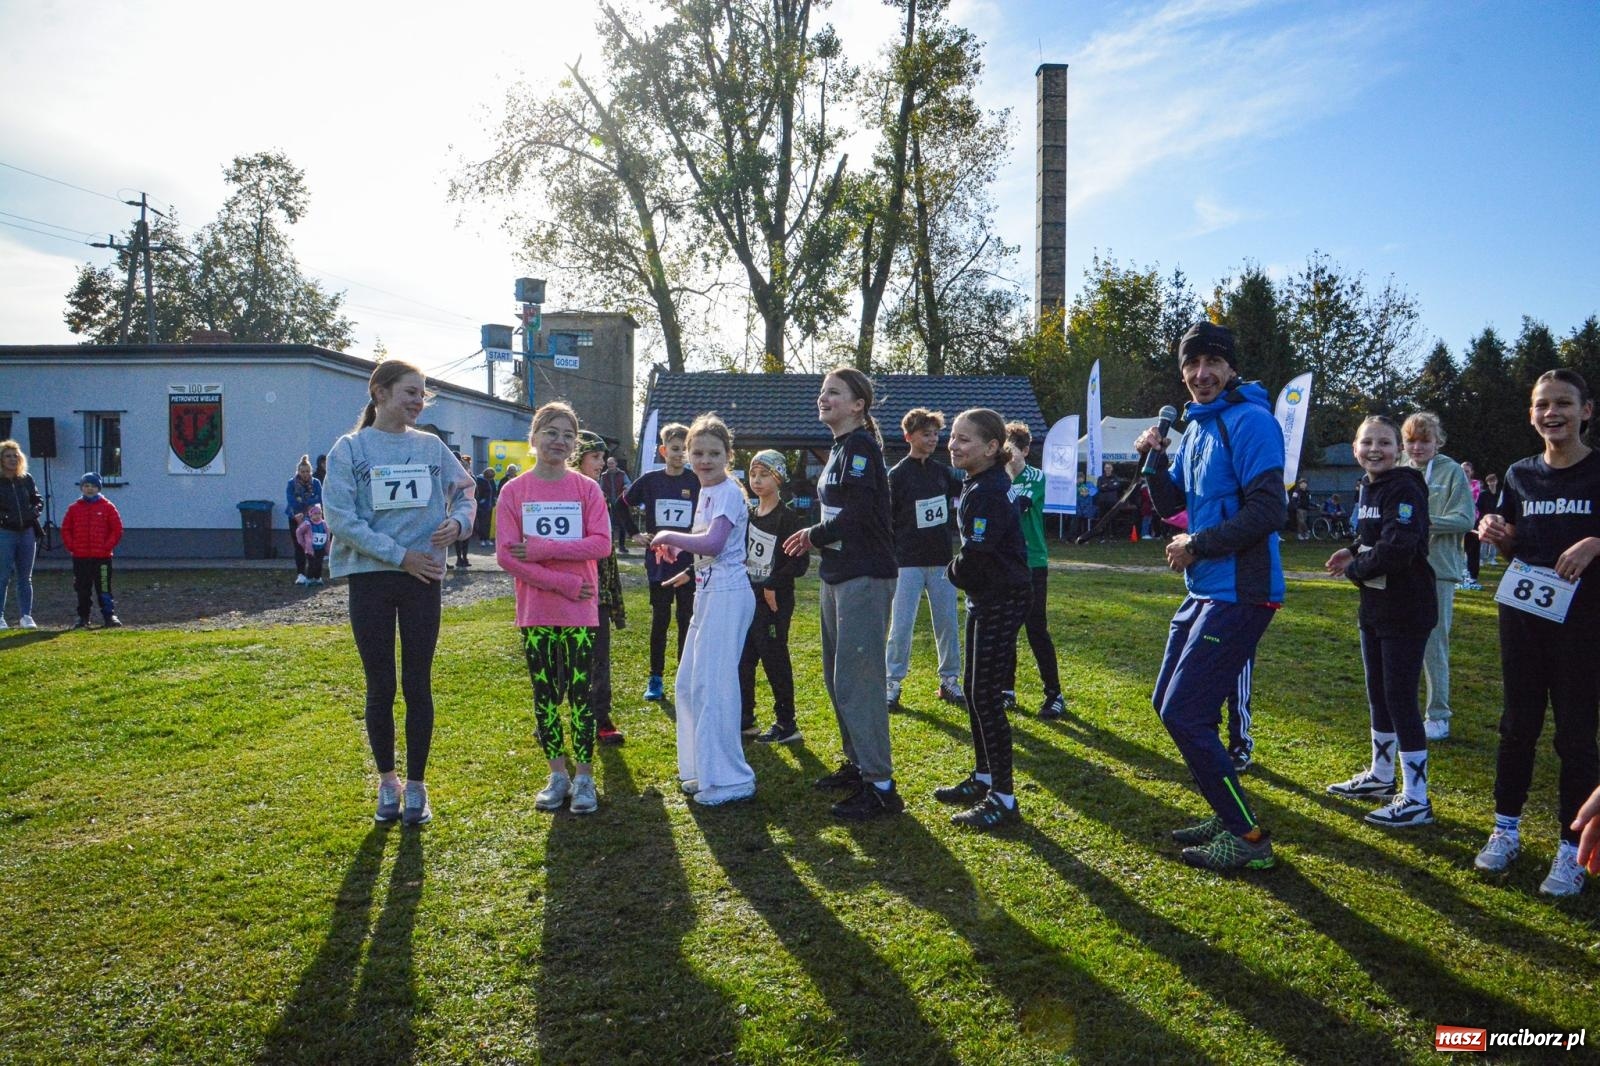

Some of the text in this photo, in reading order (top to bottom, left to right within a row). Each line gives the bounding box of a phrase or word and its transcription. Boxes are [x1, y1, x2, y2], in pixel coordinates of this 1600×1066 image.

[488, 351, 510, 360] START
[555, 357, 578, 367] GOŚCIE
[188, 384, 203, 394] 100
[385, 480, 418, 500] 71
[663, 509, 684, 521] 17
[925, 506, 943, 522] 84
[536, 516, 570, 536] 69
[750, 537, 764, 557] 79
[1513, 578, 1556, 608] 83
